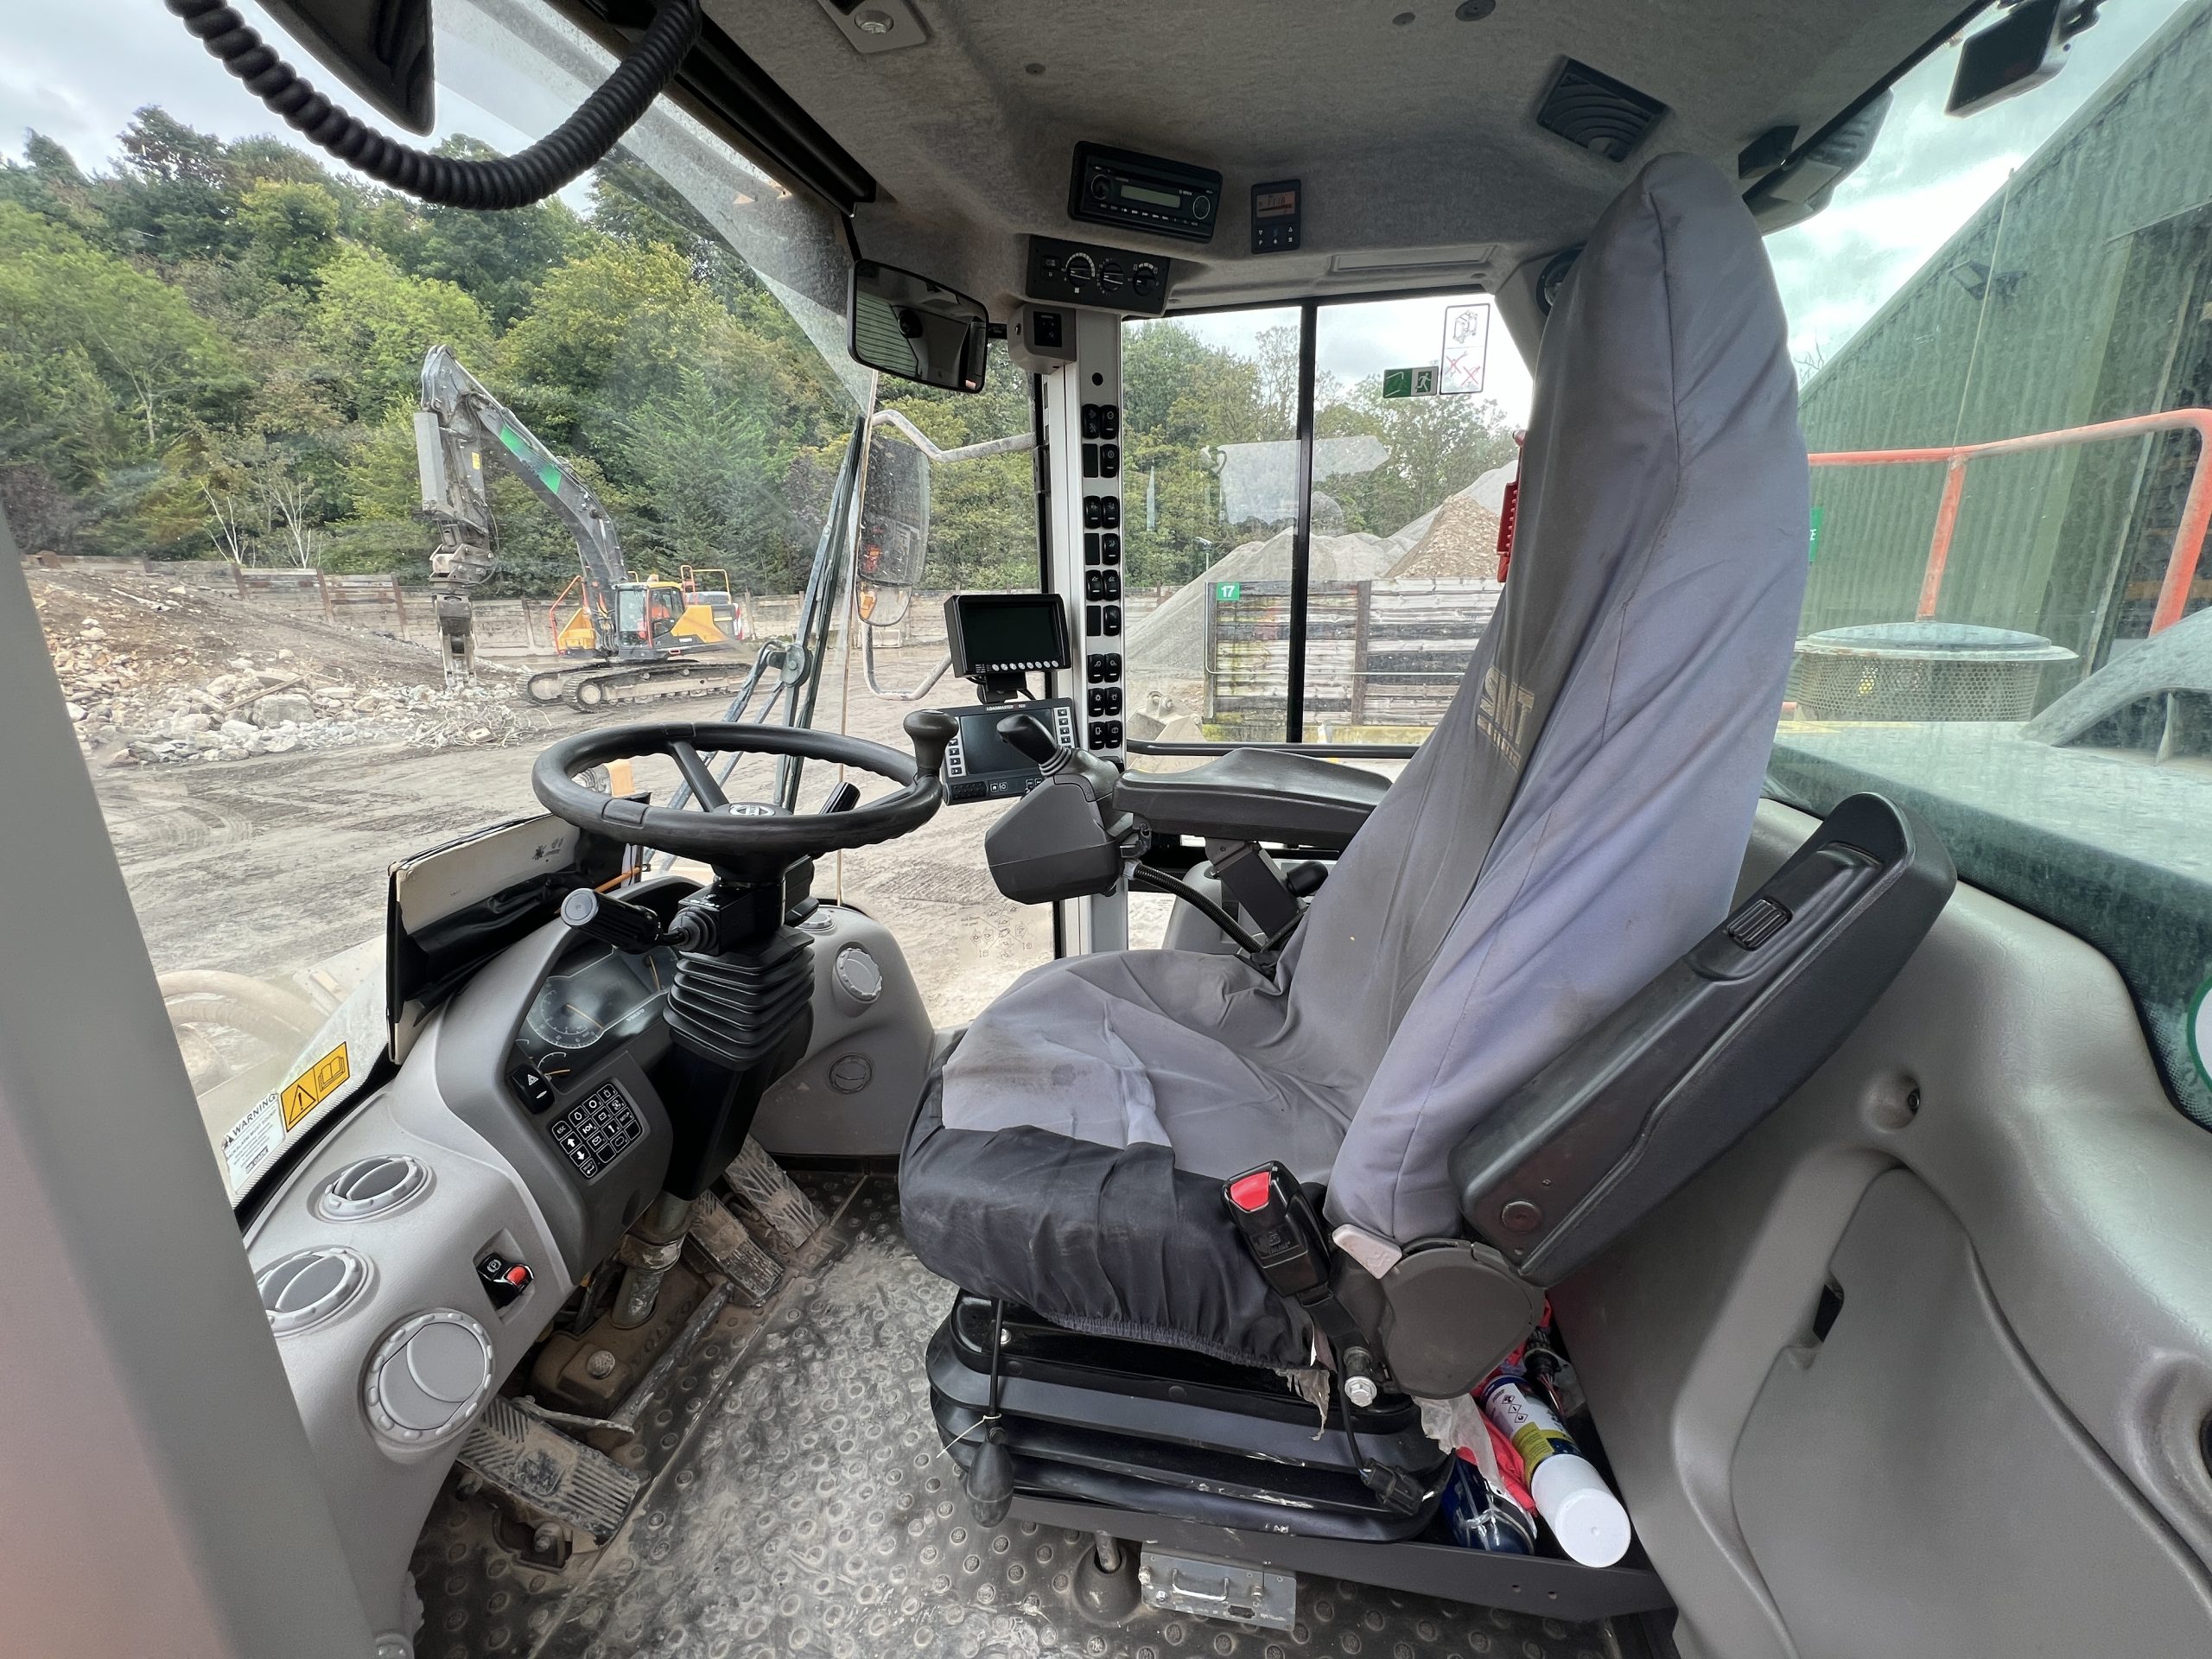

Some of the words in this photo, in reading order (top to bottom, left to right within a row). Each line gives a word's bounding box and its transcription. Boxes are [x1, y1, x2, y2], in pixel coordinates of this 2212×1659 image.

[1221, 585, 1236, 598] 17
[232, 1093, 277, 1136] WARNING
[556, 1125, 567, 1135] ESC
